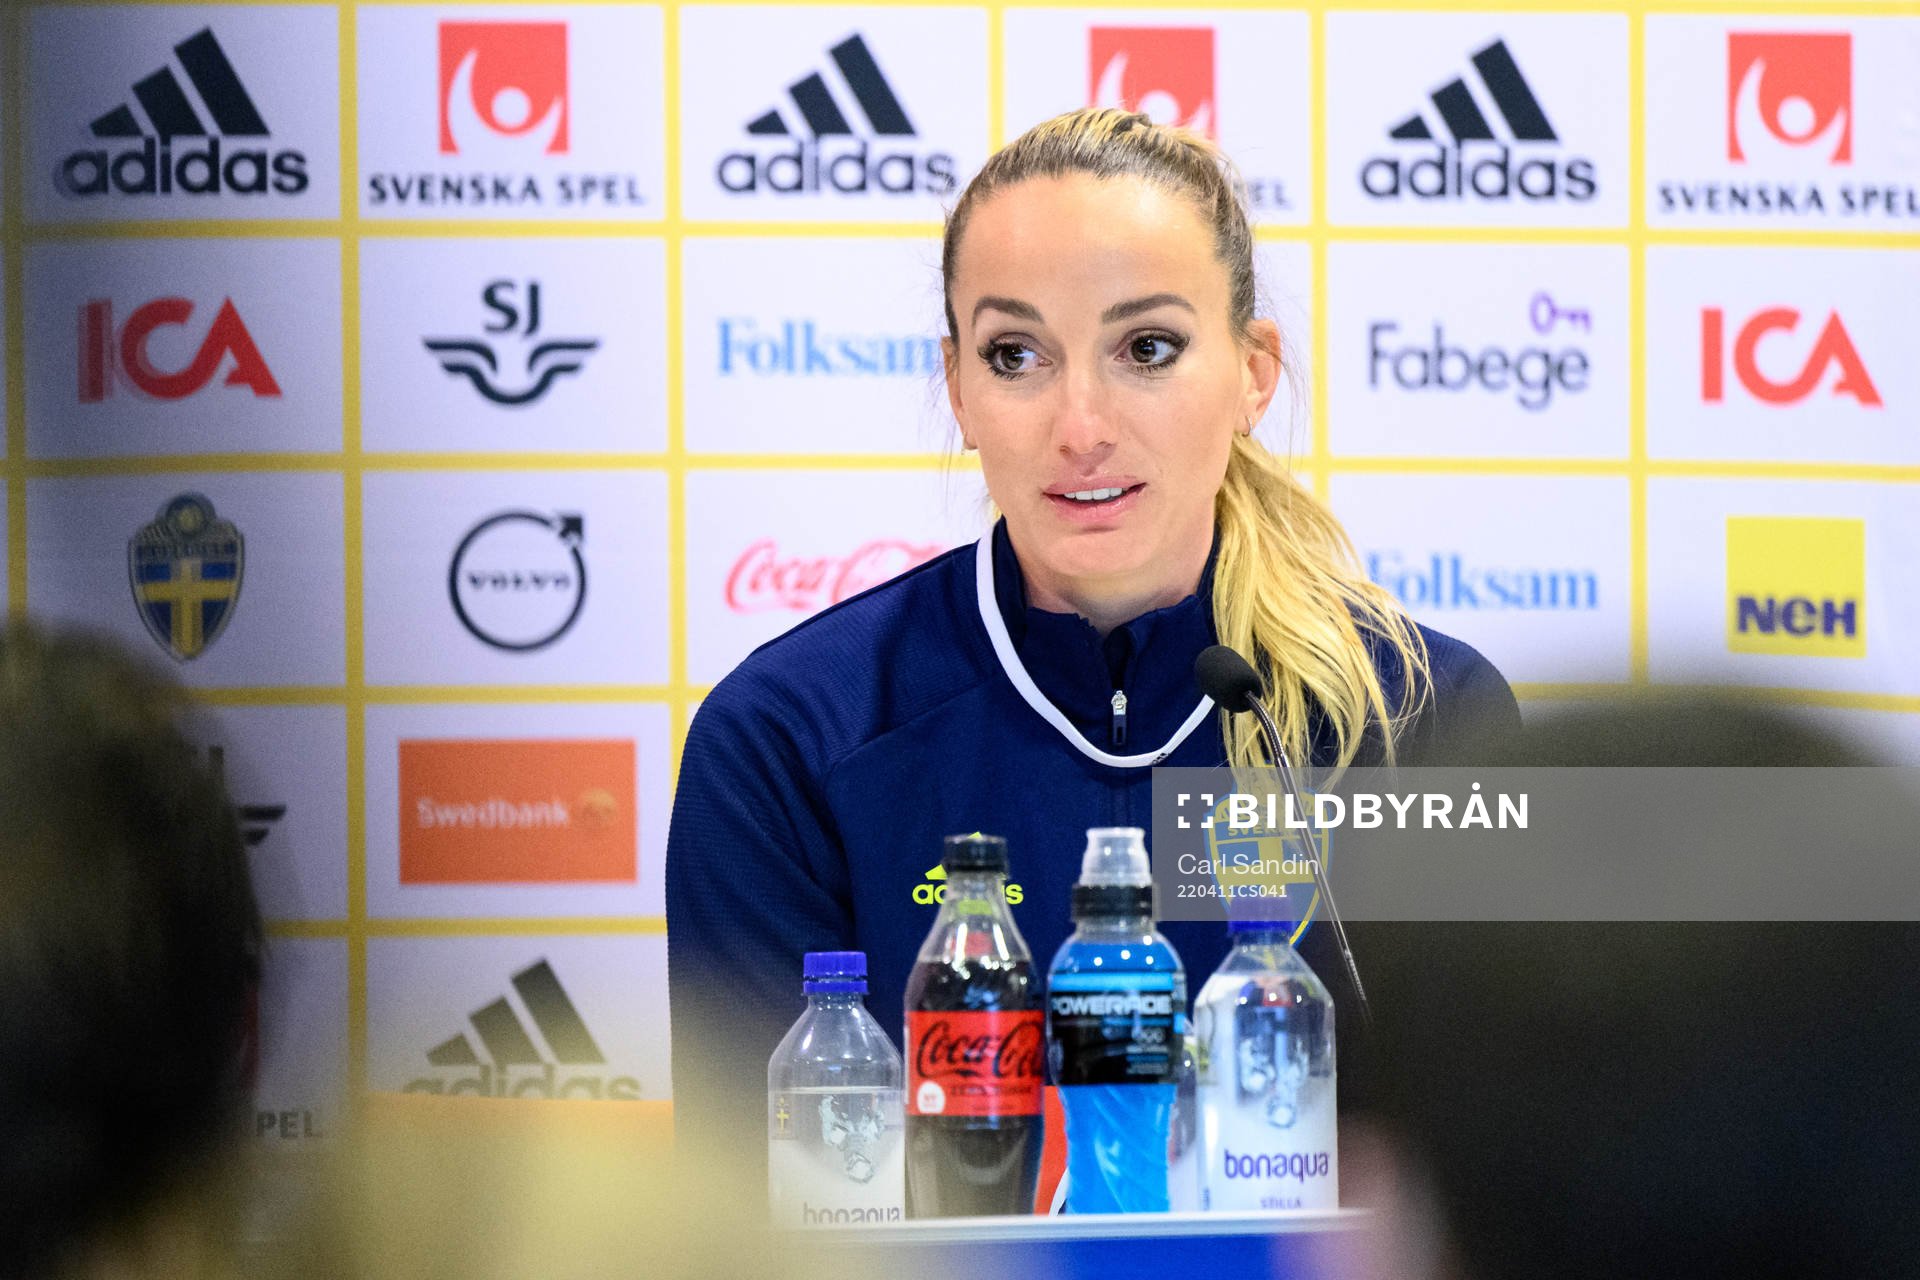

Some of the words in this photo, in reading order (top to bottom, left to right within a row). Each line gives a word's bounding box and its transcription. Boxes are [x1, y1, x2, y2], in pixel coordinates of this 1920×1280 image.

[56, 137, 309, 195] adidas
[718, 140, 957, 193] adidas
[1361, 146, 1597, 199] adidas
[369, 173, 541, 206] SVENSKA
[557, 174, 646, 206] SPEL
[1659, 181, 1824, 213] SVENSKA
[1841, 183, 1920, 214] SPEL
[481, 280, 541, 336] SJ
[78, 297, 283, 403] ICA
[1369, 322, 1590, 411] Fabege
[1701, 306, 1884, 407] ICA
[468, 571, 571, 591] VOLVO
[1738, 597, 1856, 636] NCH
[416, 798, 569, 829] Swedbank
[256, 1110, 323, 1138] PEL
[1224, 1149, 1329, 1183] bonaqua
